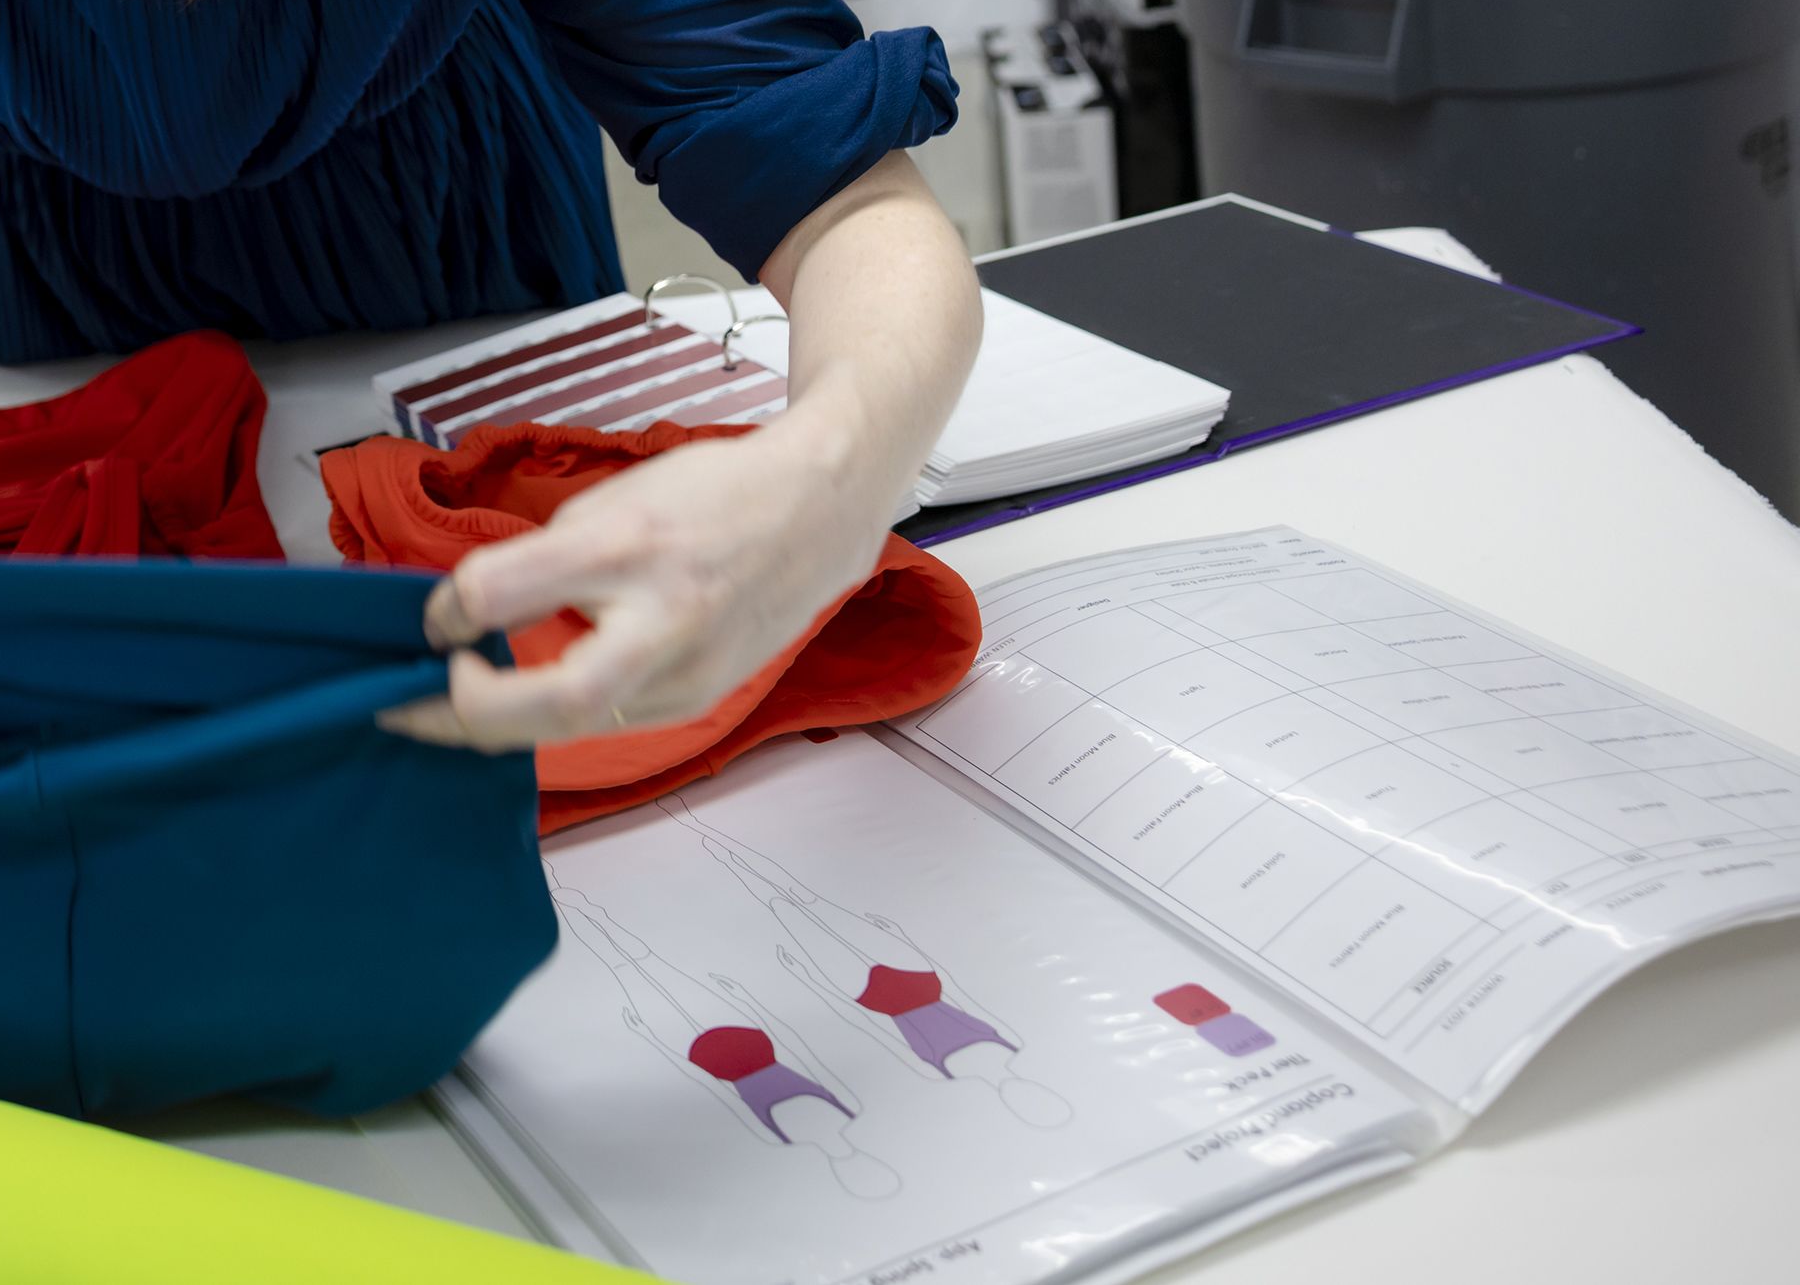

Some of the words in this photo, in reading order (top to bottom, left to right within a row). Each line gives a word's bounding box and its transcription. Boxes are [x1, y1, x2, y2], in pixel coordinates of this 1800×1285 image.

[1076, 597, 1110, 611] Designer
[991, 638, 1016, 654] ELLEN
[1178, 682, 1205, 698] Tights
[1098, 732, 1116, 749] Blue
[1264, 730, 1299, 749] Leotard
[1075, 745, 1098, 766] Moon
[1047, 762, 1077, 786] Fabrics
[1184, 784, 1203, 800] Blue
[1160, 795, 1186, 817] Moon
[1132, 813, 1162, 842] Fabrics
[1262, 852, 1285, 870] Solid
[1239, 867, 1264, 889] Stone
[1384, 903, 1405, 922] Blue
[1360, 917, 1385, 942] Moon
[1328, 937, 1361, 969] Fabrics
[1410, 957, 1452, 995] SOURCE
[1271, 1051, 1311, 1072] Tiler
[1224, 1066, 1273, 1091] Peck
[1264, 1081, 1356, 1128] Copland
[1184, 1122, 1264, 1163] Project
